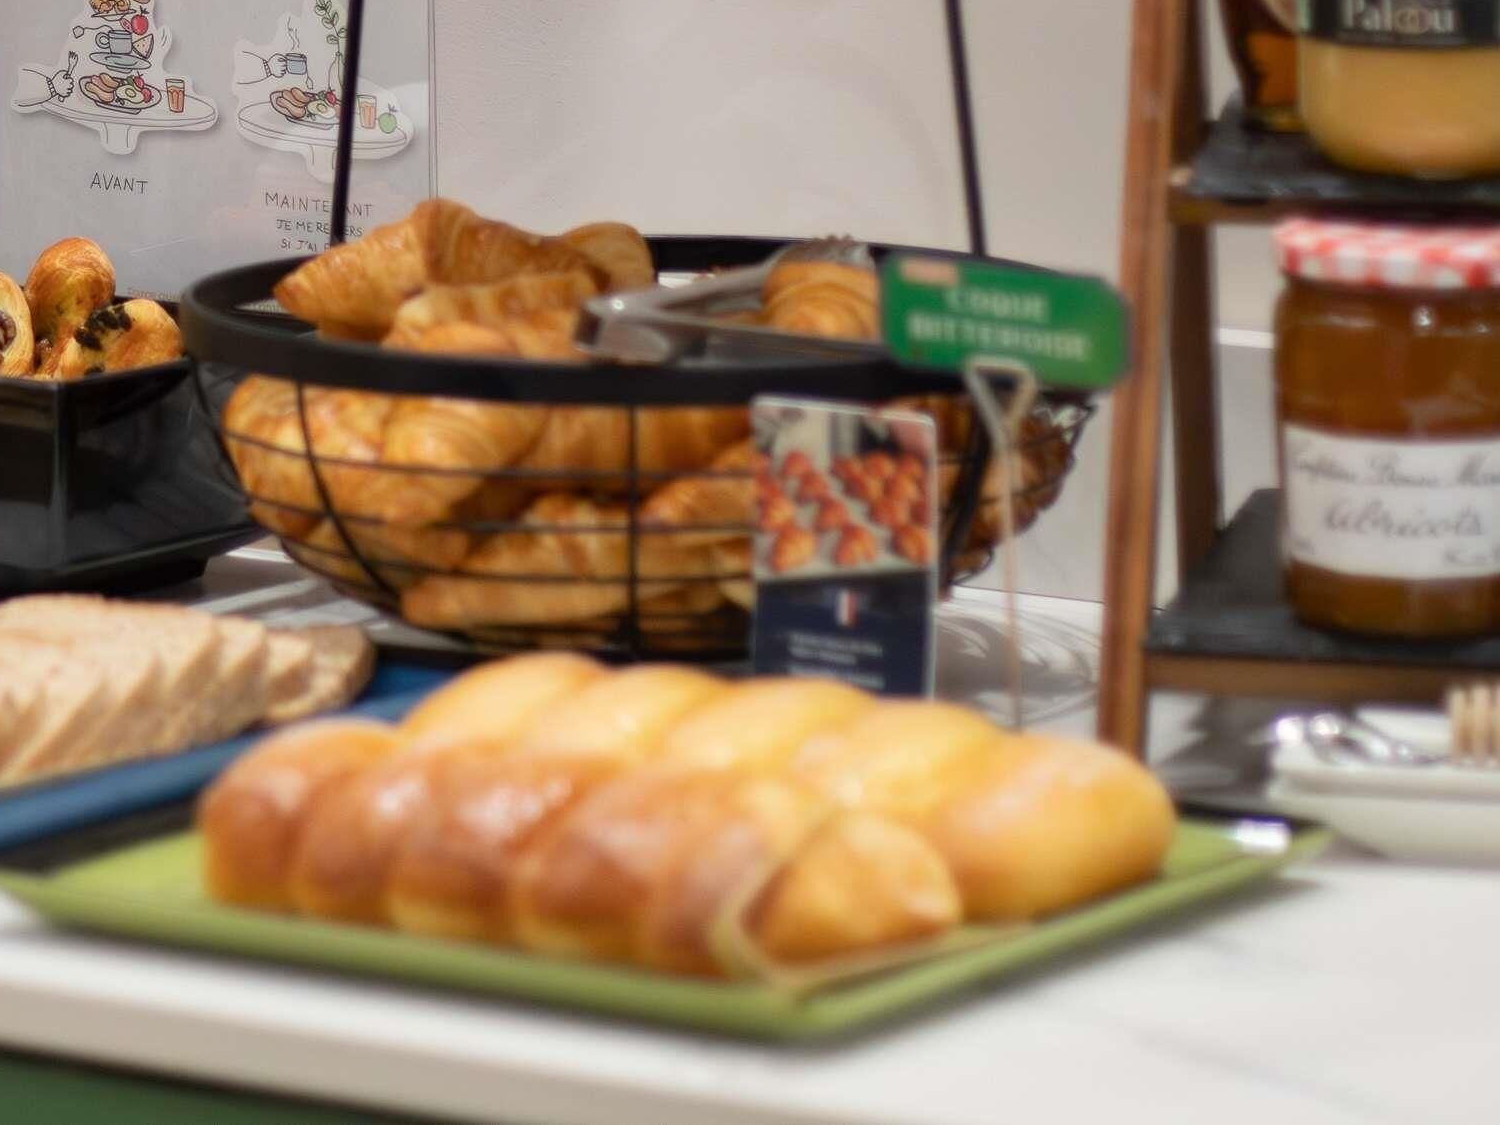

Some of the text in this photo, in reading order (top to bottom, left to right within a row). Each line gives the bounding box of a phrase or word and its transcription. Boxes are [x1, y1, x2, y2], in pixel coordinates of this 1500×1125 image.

[90, 172, 148, 194] AVANT
[265, 192, 372, 217] MAINTEANT
[276, 219, 364, 237] JE ME REERS
